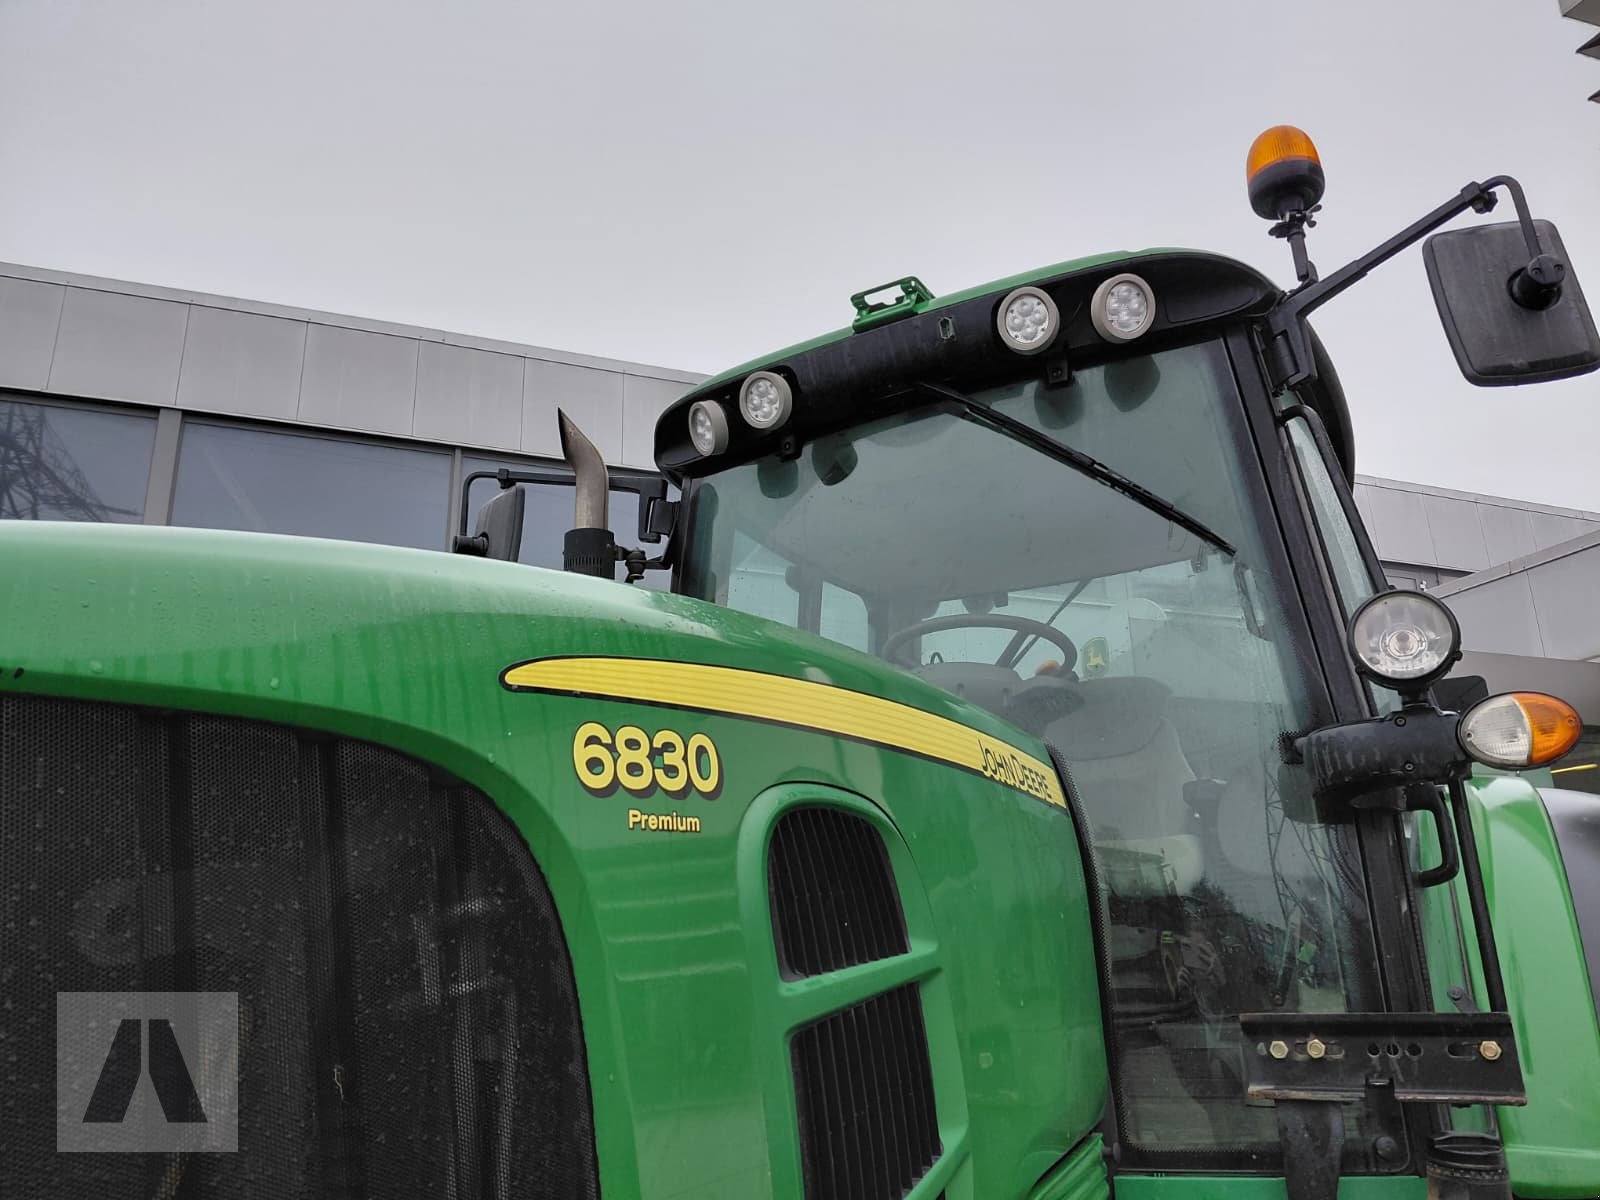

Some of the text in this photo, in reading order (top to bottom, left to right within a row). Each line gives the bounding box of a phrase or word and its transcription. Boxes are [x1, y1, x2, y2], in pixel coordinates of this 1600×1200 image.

[573, 721, 723, 799] 6830
[978, 739, 1052, 799] JOHN DEERE
[628, 808, 701, 832] Premium
